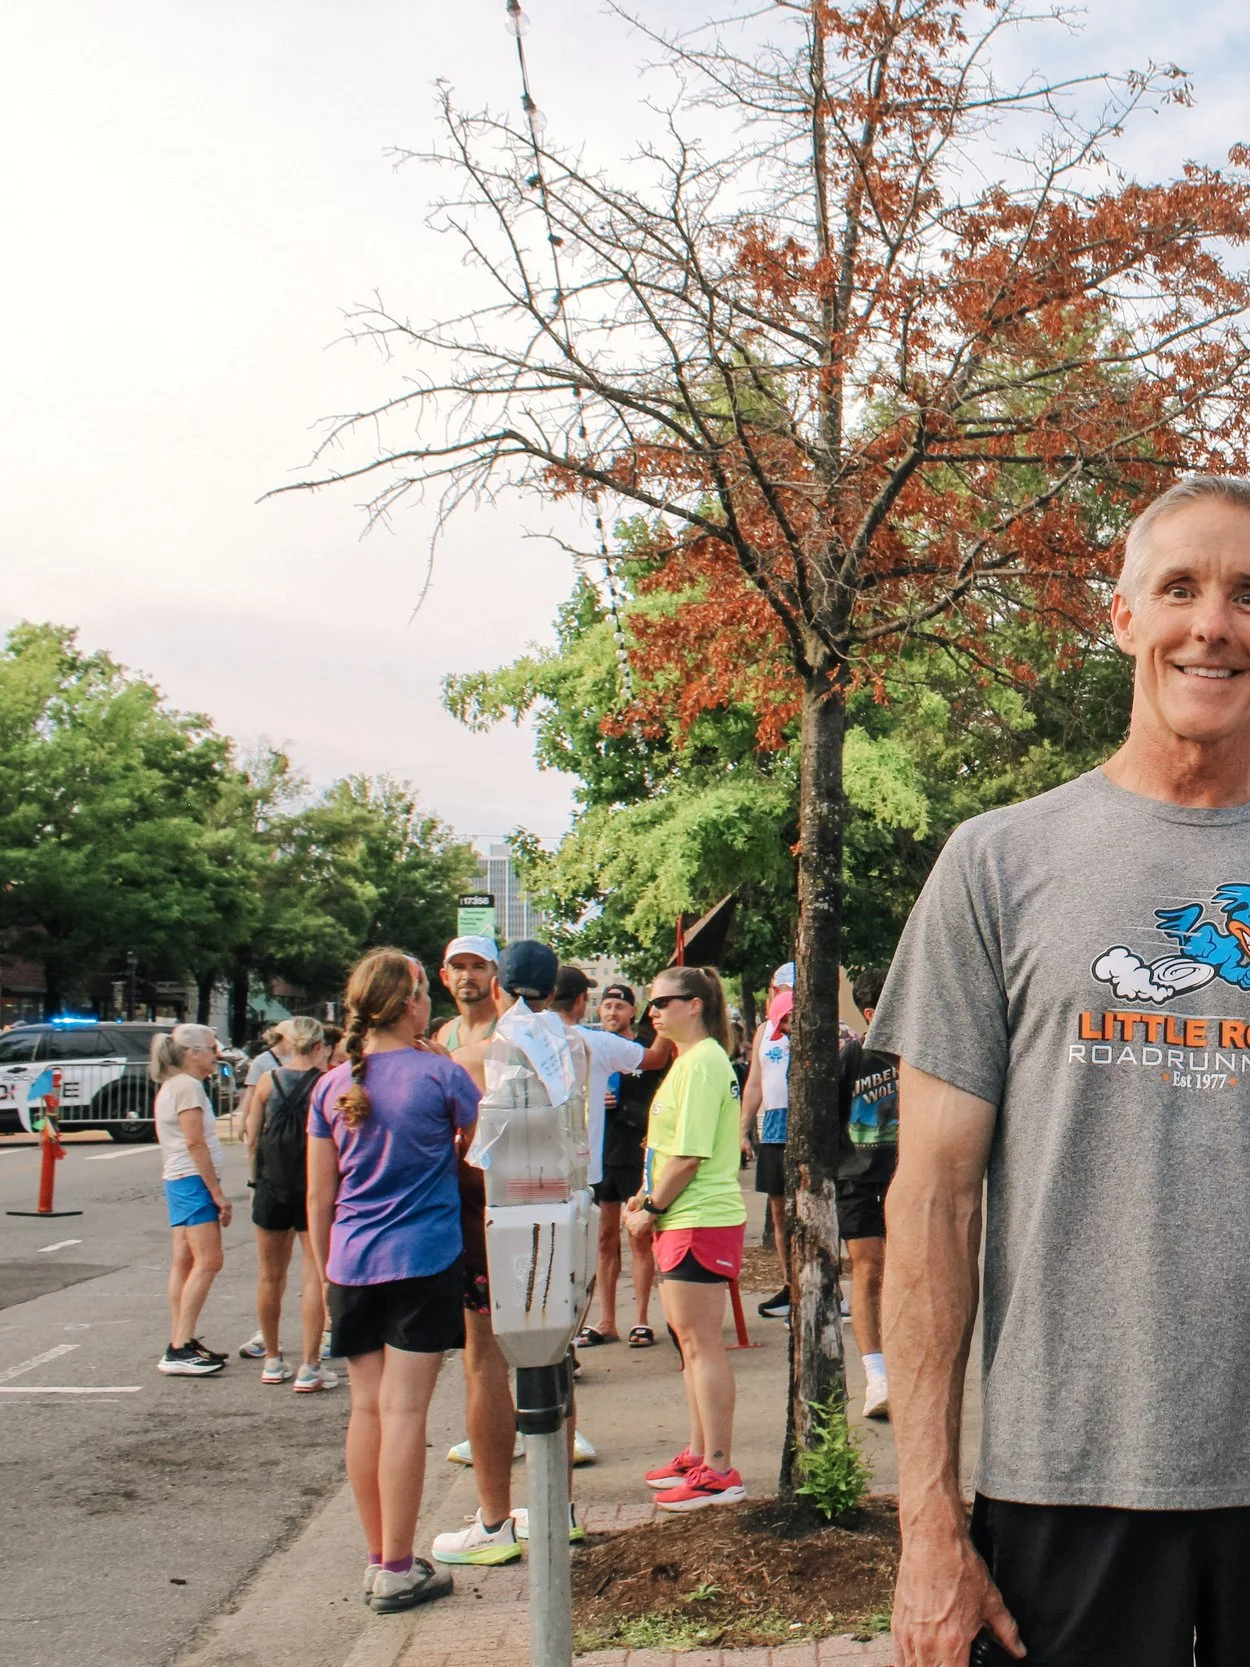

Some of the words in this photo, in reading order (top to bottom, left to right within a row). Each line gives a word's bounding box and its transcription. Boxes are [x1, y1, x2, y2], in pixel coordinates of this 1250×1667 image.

[1078, 1009, 1208, 1048] LITTLE
[1172, 1070, 1192, 1088] Est
[1195, 1072, 1227, 1090] 1977
